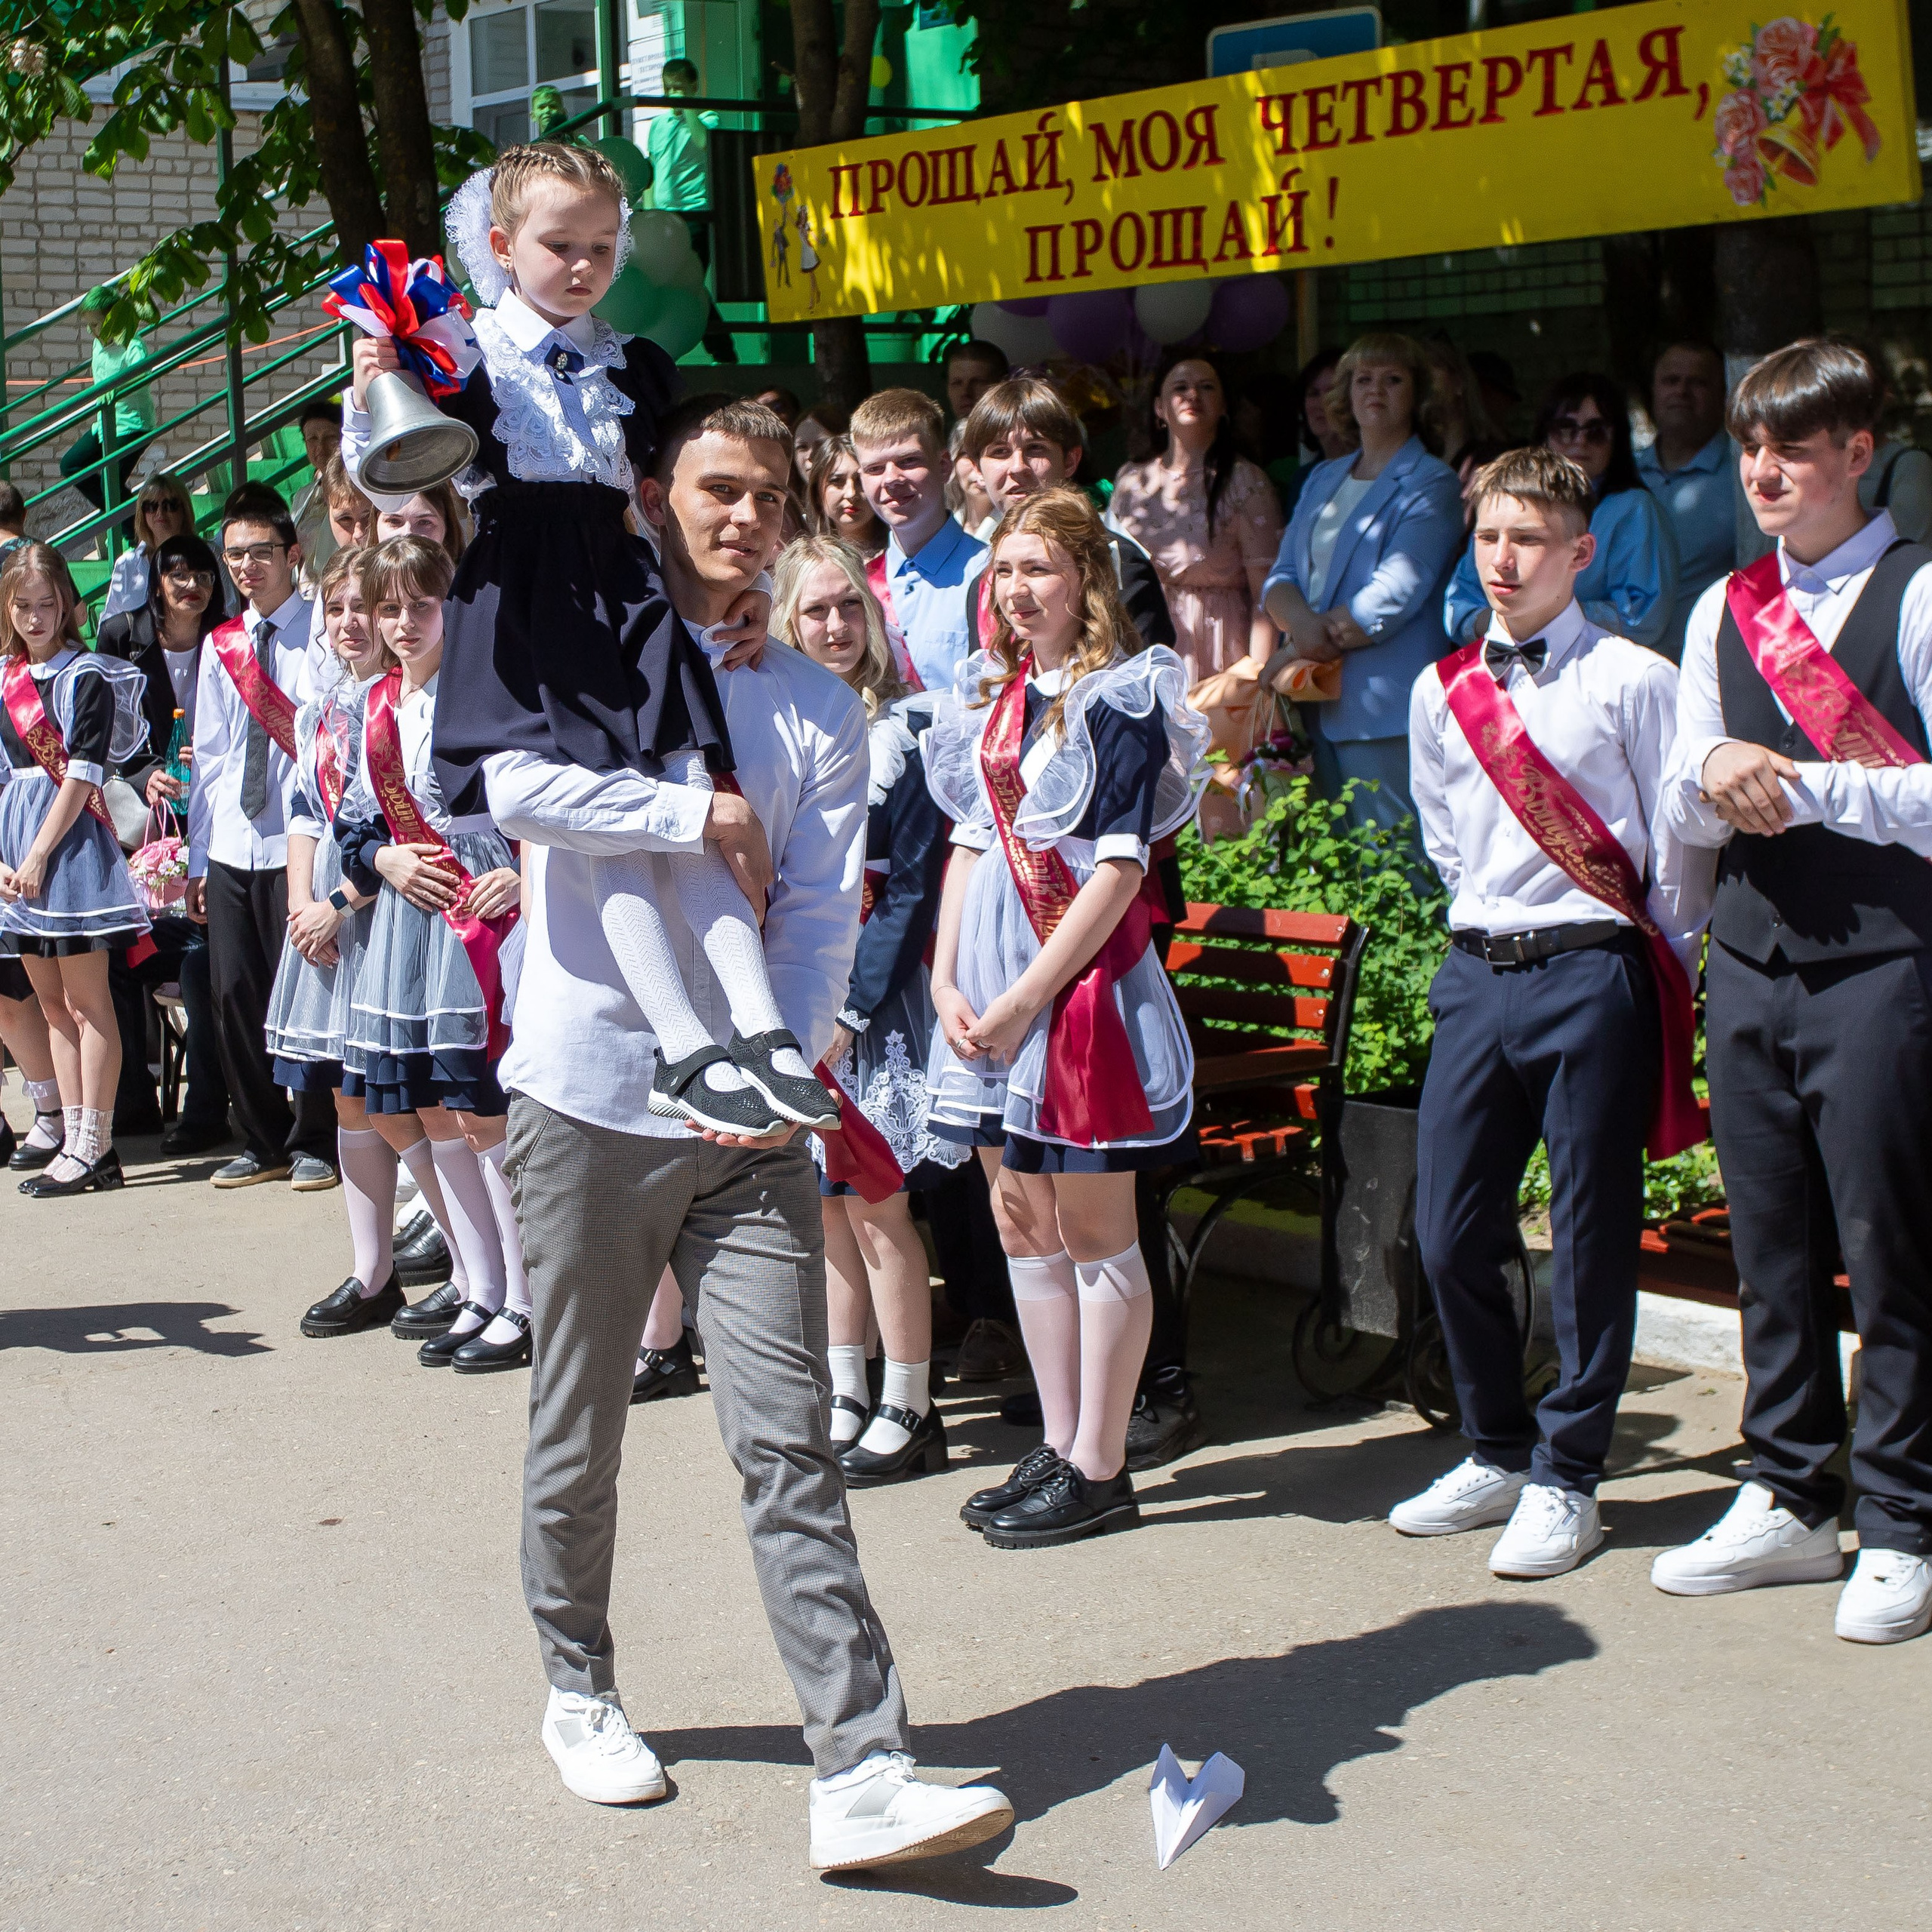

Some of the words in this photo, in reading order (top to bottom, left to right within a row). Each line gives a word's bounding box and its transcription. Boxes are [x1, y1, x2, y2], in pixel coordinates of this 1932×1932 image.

[828, 111, 1075, 220] ПРОЩАЙ,
[1088, 104, 1226, 183] МОЯ
[1255, 26, 1711, 157] ЧЕТВЕРТАЯ,
[1025, 166, 1339, 284] ПРОЩАЙ!
